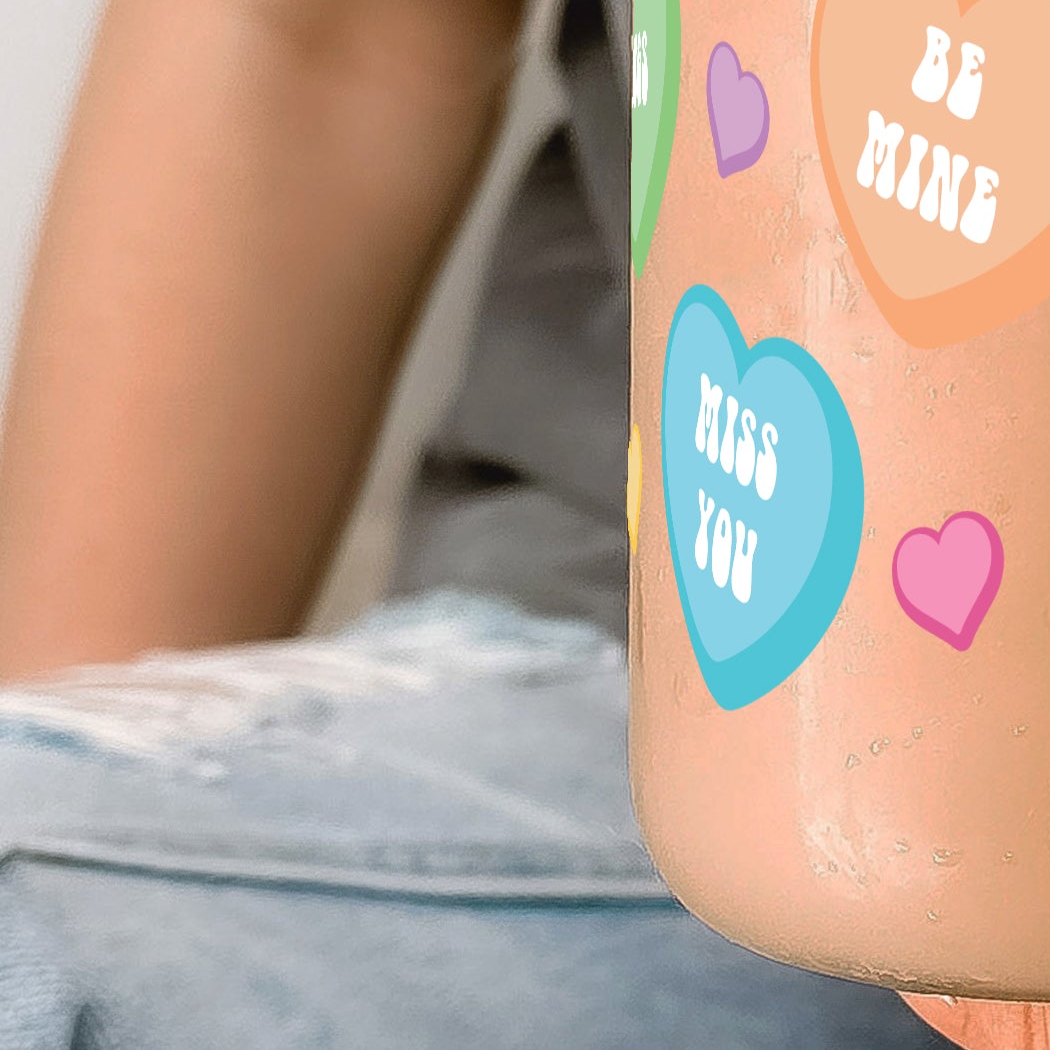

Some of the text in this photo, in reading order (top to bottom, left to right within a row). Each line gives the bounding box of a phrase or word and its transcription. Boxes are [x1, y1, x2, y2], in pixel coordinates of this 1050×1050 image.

[911, 26, 985, 120] BE
[857, 110, 999, 244] MINE
[695, 373, 778, 500] MISS
[695, 488, 757, 603] YOU
